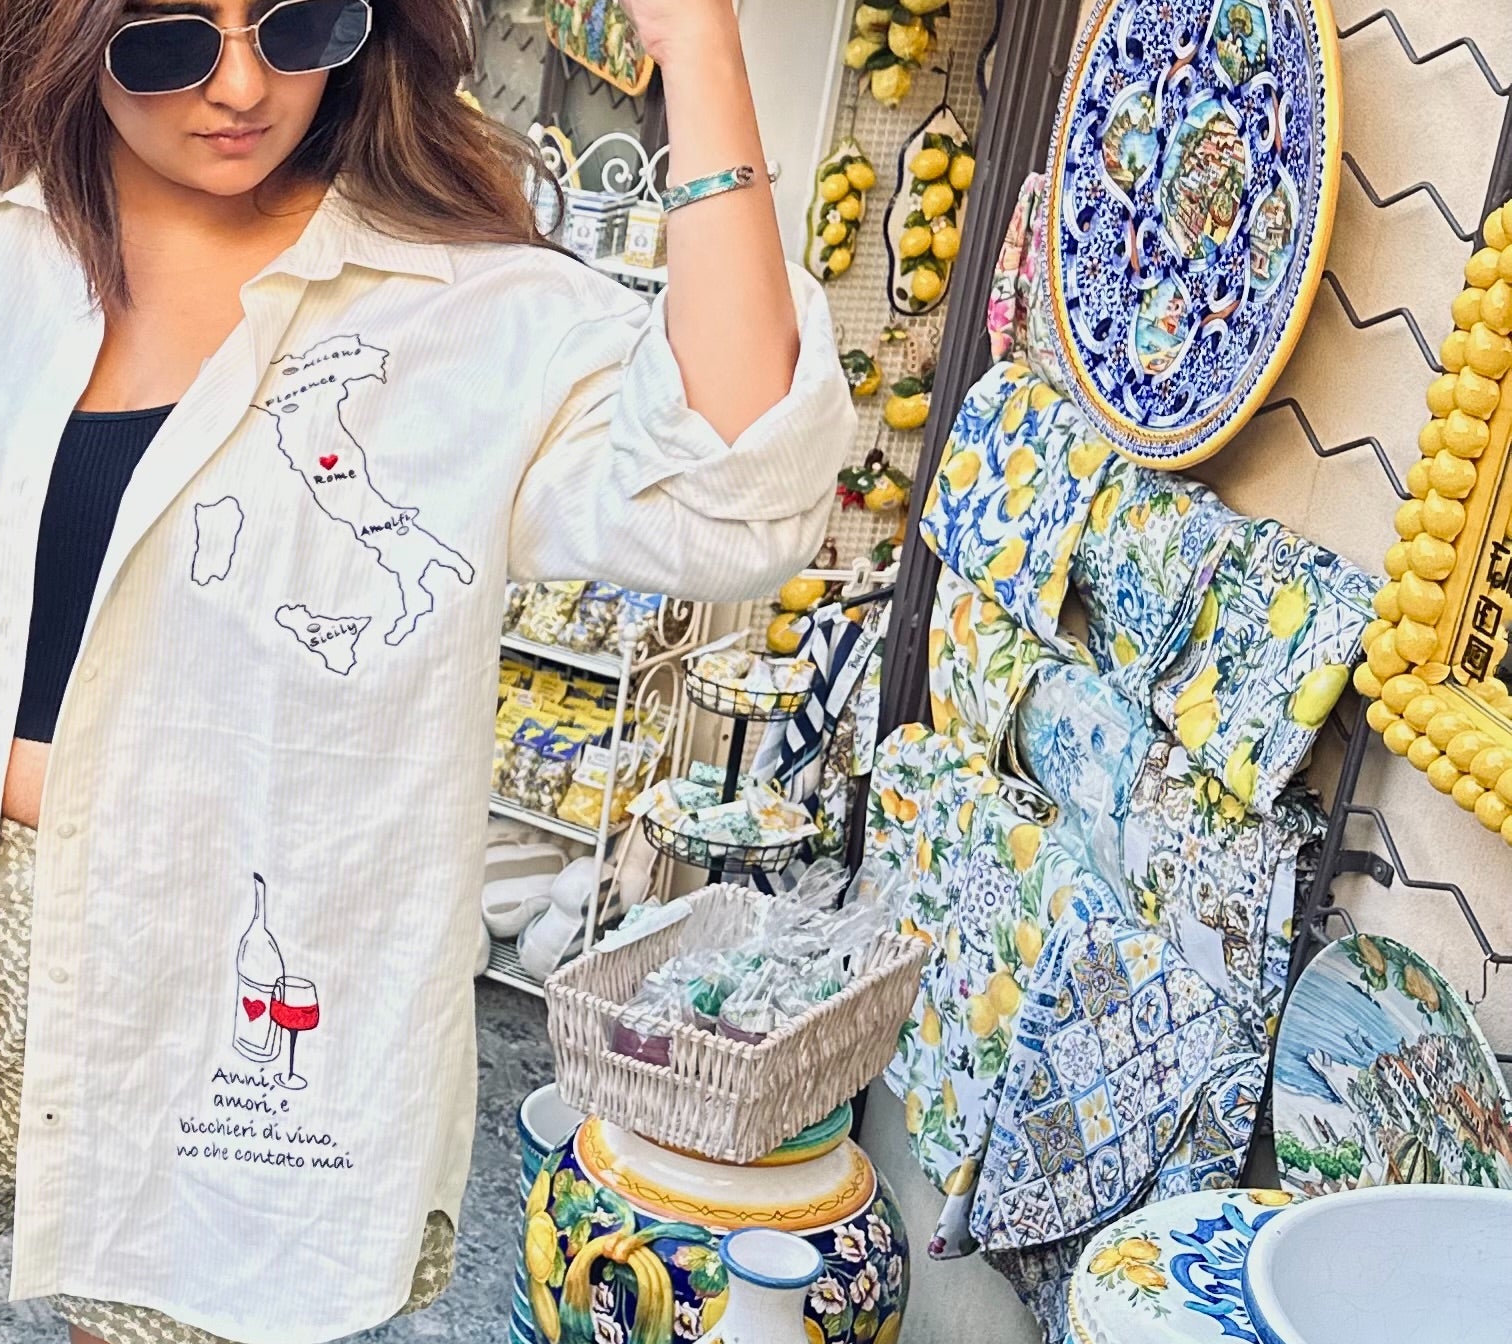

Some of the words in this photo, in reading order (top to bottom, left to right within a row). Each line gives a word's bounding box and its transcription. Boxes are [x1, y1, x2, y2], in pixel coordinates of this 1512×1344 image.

[314, 469, 357, 485] Rome
[360, 512, 412, 537] Amalfi
[310, 622, 358, 647] Sicily
[211, 1067, 275, 1091] Anni,
[213, 1093, 277, 1116] amori,
[179, 1118, 257, 1139] bicchieri
[262, 1120, 282, 1142] di
[286, 1126, 337, 1148] vino,
[176, 1145, 199, 1159] no
[203, 1143, 229, 1161] che
[234, 1146, 305, 1169] contato
[311, 1152, 354, 1170] mai
